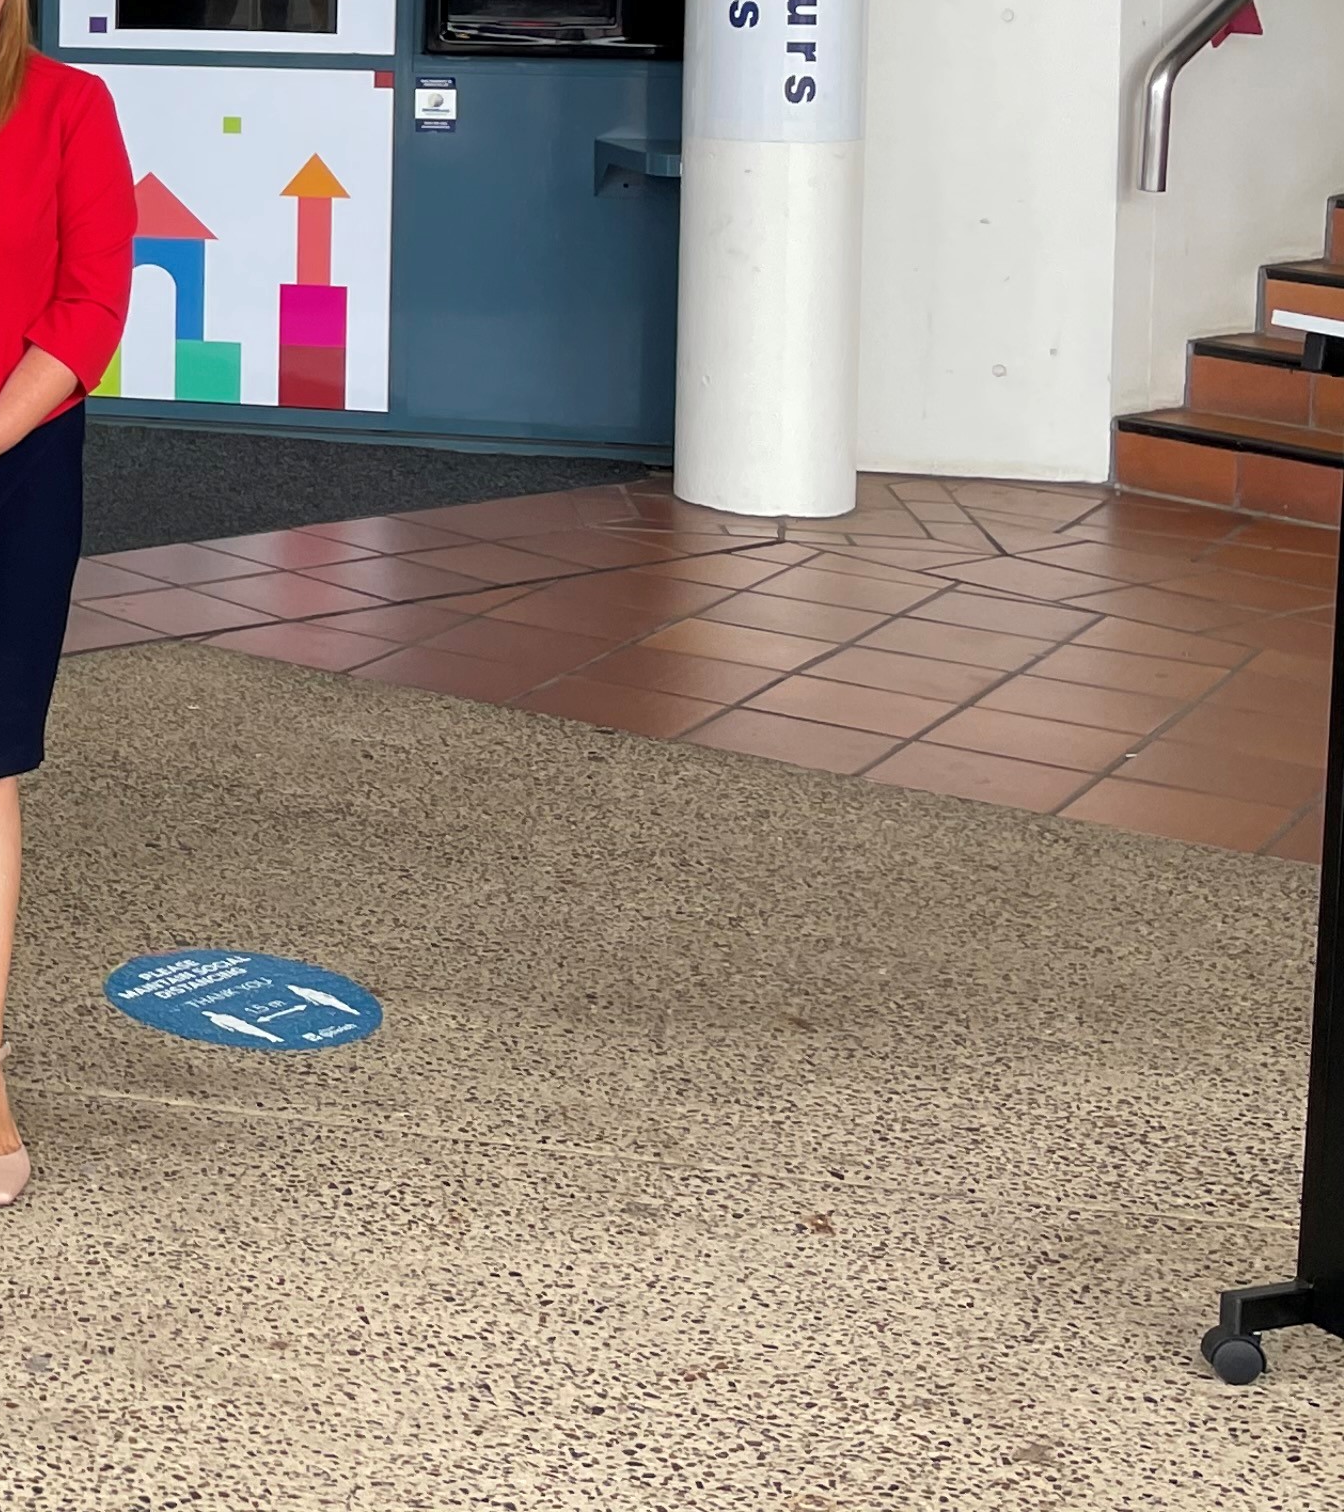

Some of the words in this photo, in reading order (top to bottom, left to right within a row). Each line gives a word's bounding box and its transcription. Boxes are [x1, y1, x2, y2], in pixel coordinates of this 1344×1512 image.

[118, 970, 197, 1000] MAINTAIN
[196, 954, 252, 975] SOCIAL
[138, 959, 200, 982] PLEASE
[154, 966, 247, 999] DISTANCING
[185, 988, 238, 1008] THANK
[239, 977, 274, 993] YOU
